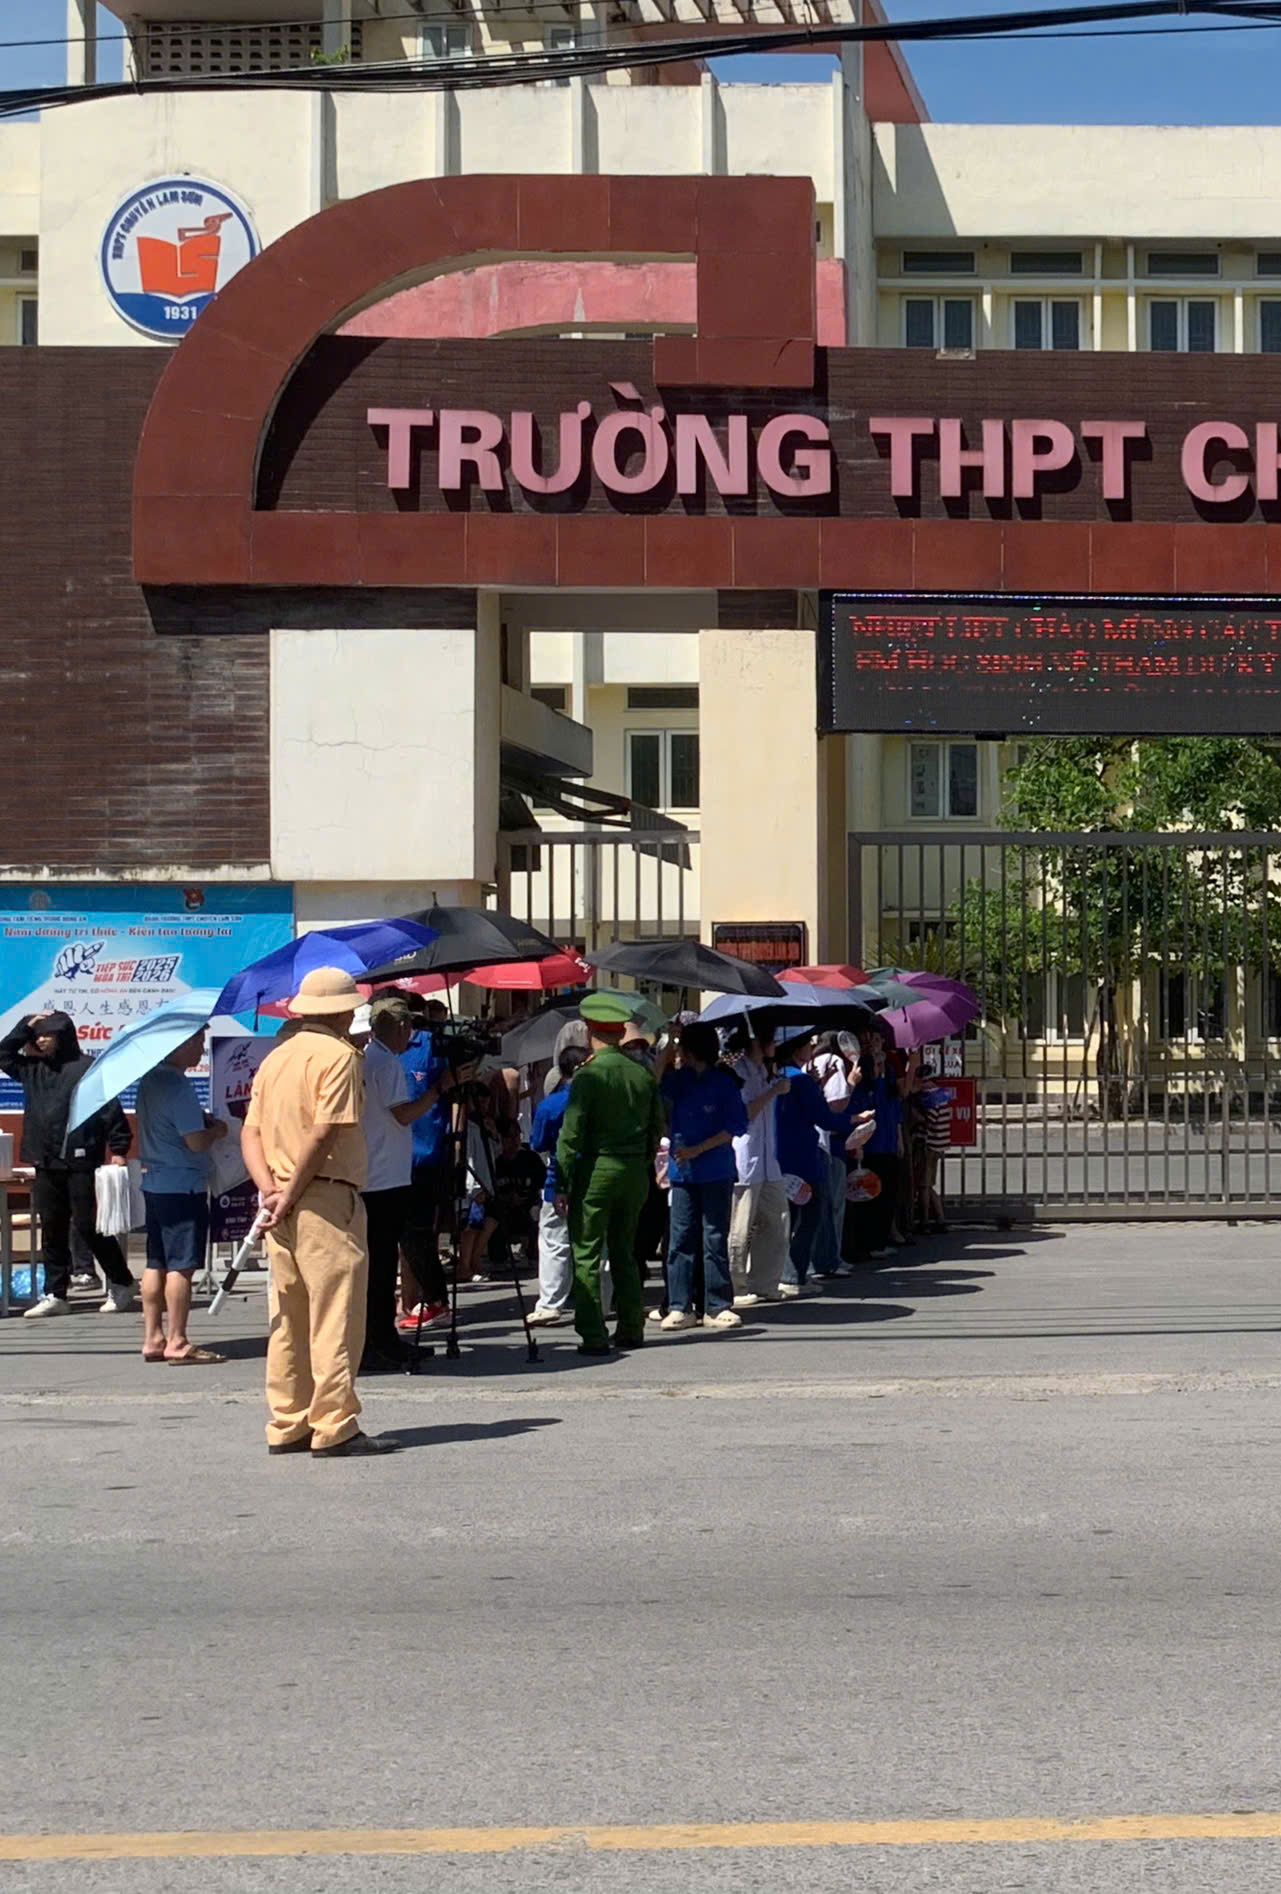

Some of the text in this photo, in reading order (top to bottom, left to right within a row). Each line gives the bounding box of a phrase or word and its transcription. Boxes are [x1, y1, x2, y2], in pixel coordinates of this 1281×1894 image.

[156, 190, 180, 207] LAM
[163, 305, 198, 320] 1931
[366, 381, 832, 498] TRƯỜNG
[868, 417, 1146, 500] THPT
[139, 956, 177, 970] 2025
[133, 970, 171, 982] 2026
